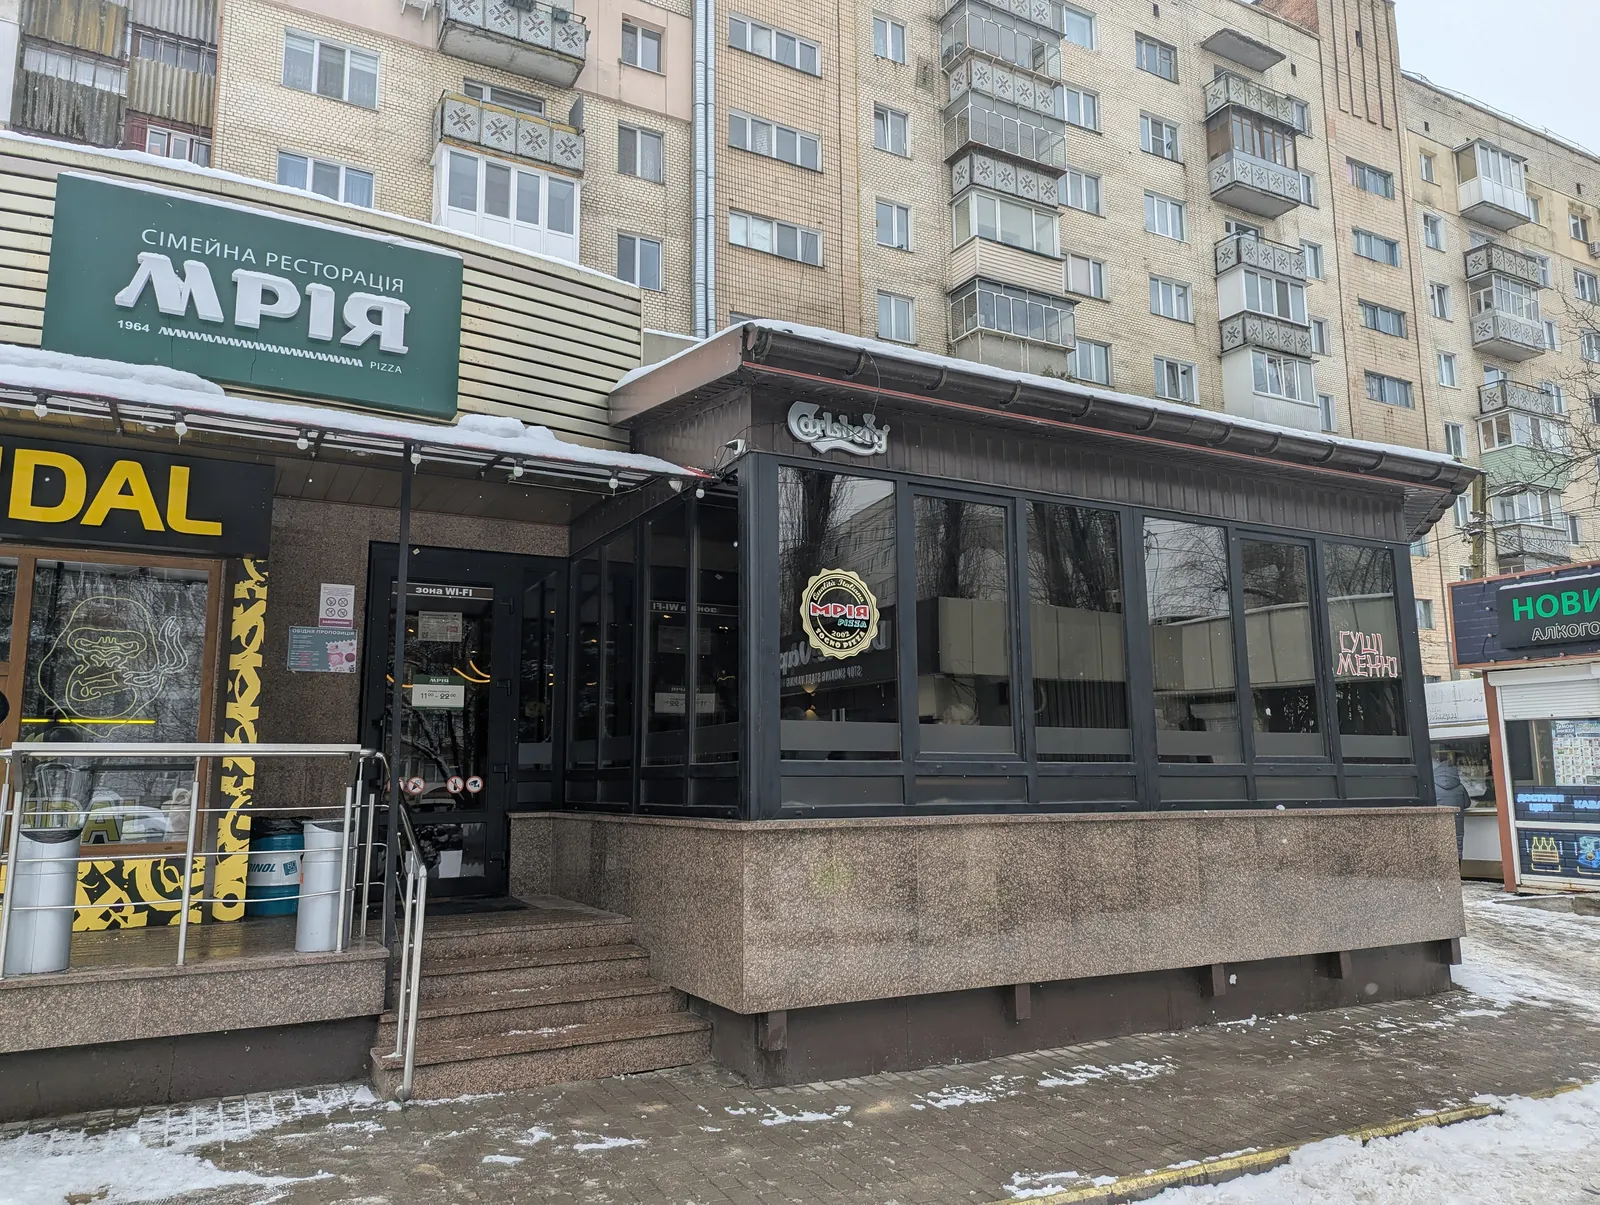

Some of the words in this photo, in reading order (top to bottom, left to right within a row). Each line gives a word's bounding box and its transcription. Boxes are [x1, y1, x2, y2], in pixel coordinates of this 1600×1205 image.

[141, 227, 257, 265] СІМЕЙНА
[266, 252, 405, 293] РЕСТОРАЦІЯ
[114, 251, 411, 355] МРІЯ
[117, 319, 150, 333] 1964
[369, 361, 402, 374] PIZZA
[0, 446, 223, 536] DAL
[415, 587, 443, 595] зона
[445, 587, 473, 597] WI-FI
[810, 601, 869, 620] МРІЯ
[1339, 630, 1383, 655] СУШІ
[1336, 652, 1398, 678] МЕНЮ
